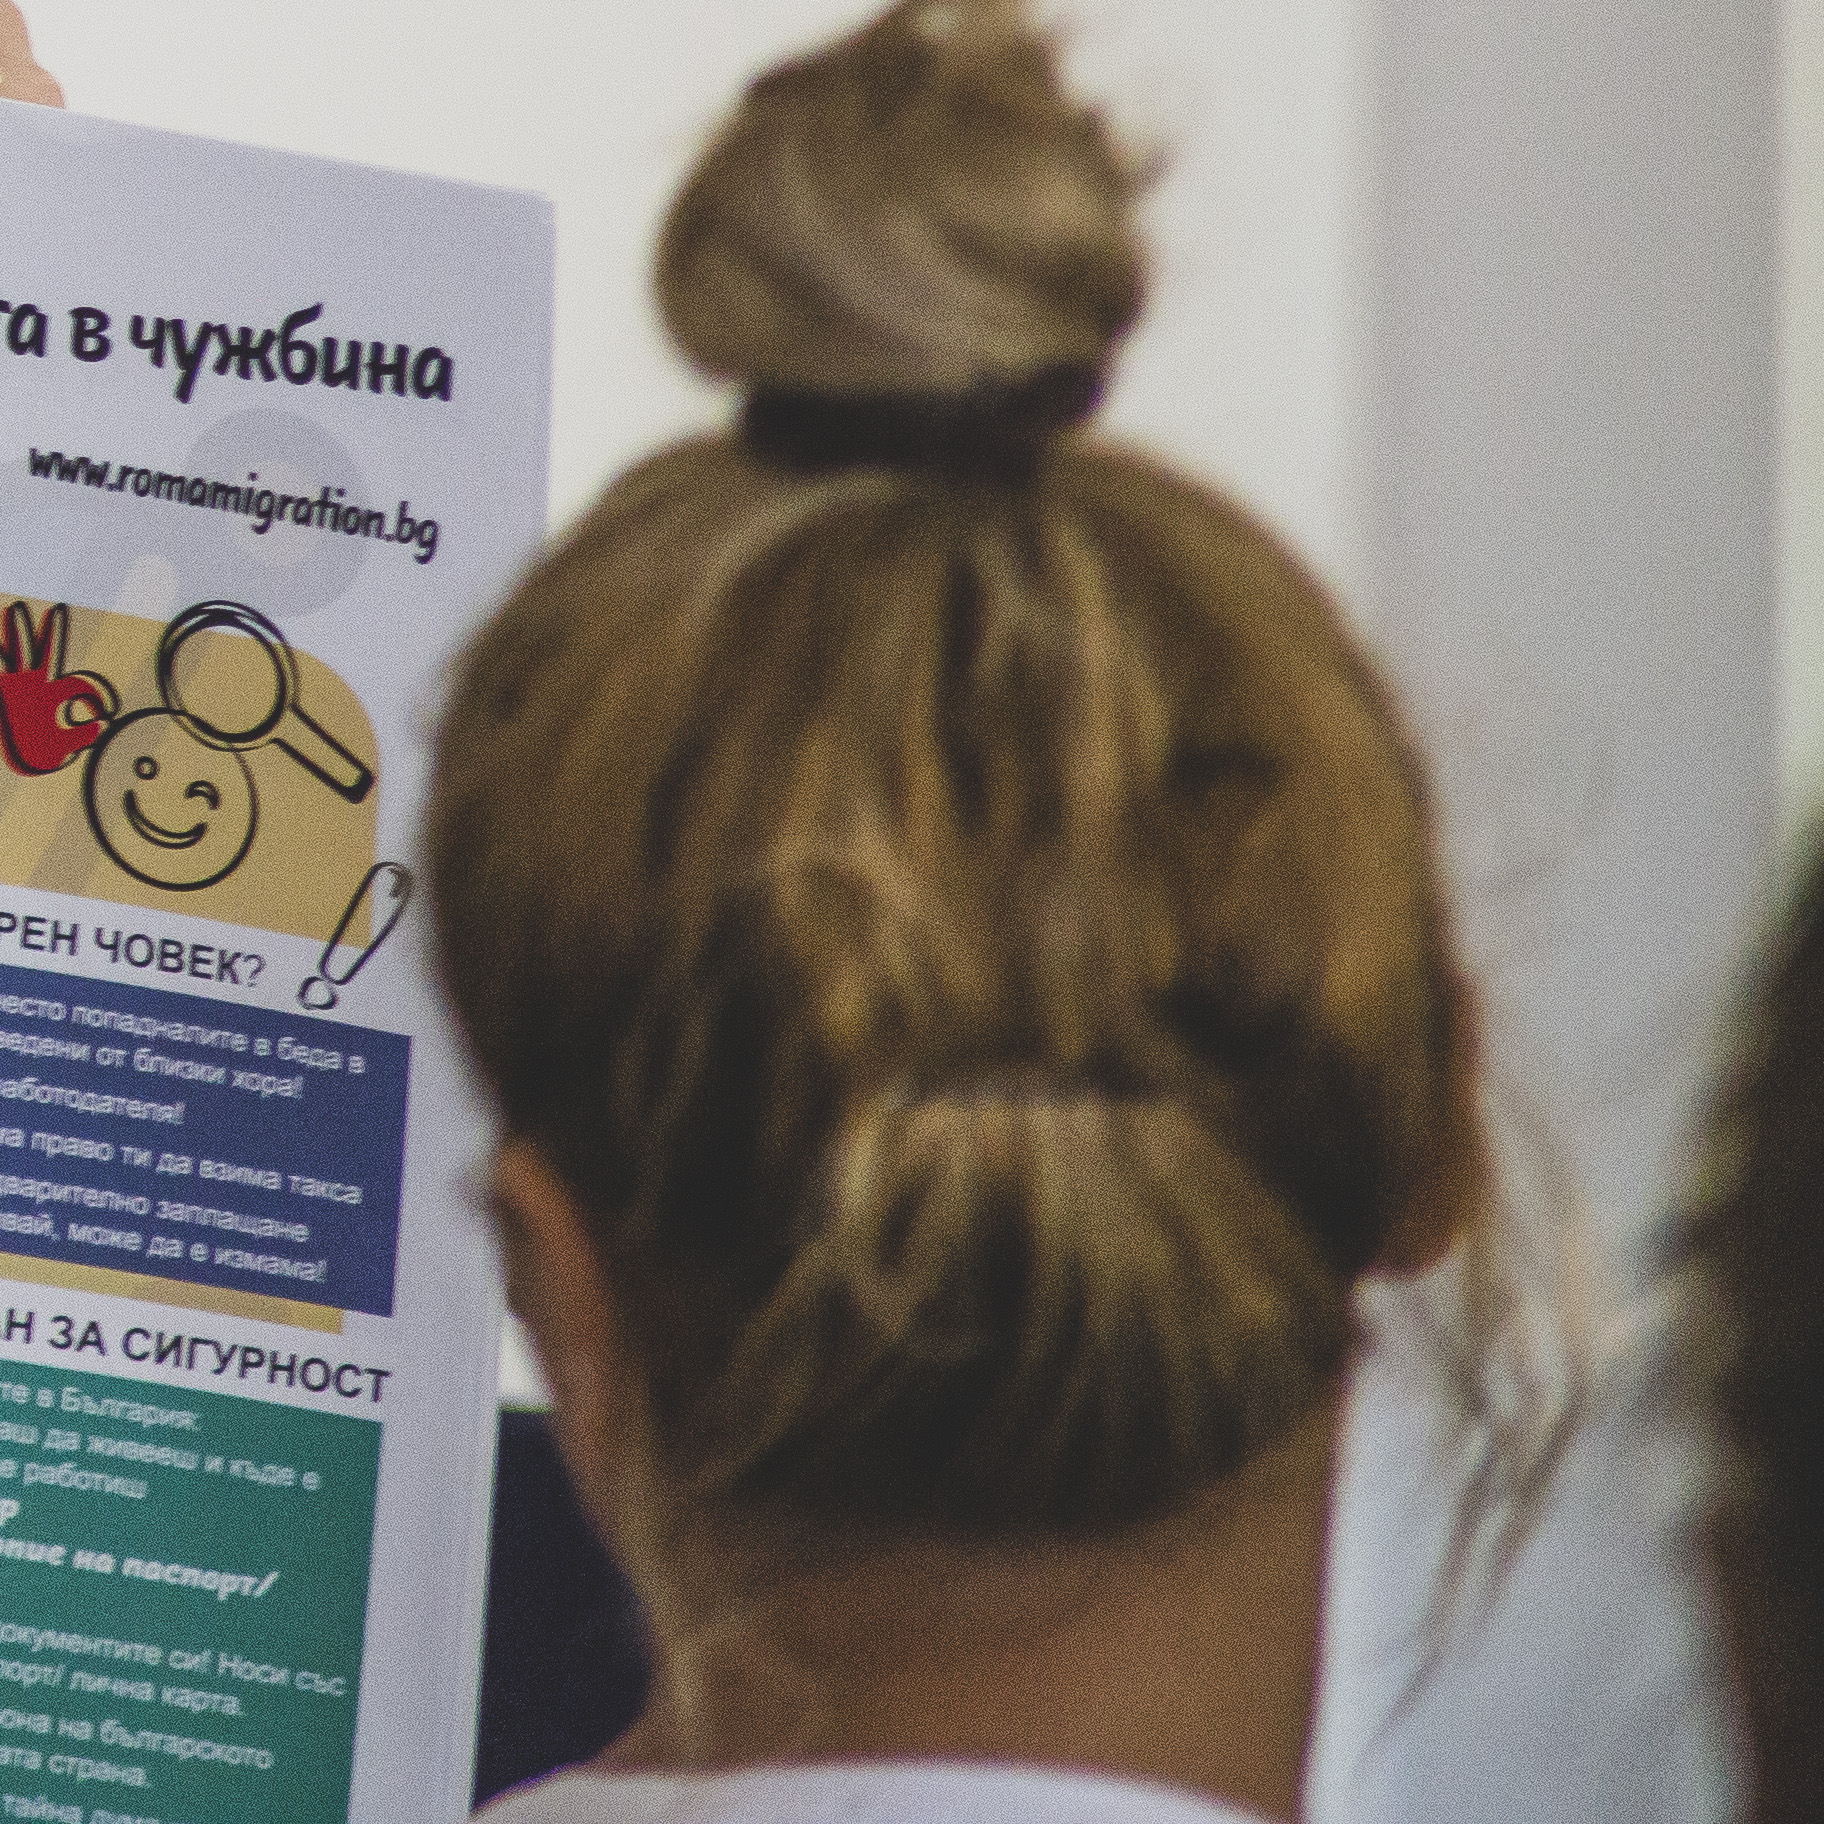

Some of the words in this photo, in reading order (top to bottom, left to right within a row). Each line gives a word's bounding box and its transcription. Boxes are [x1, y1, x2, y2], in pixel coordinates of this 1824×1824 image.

[70, 306, 110, 363] в
[130, 302, 455, 402] чужбина
[28, 446, 439, 564] www.romamigration.bg
[94, 927, 264, 984] ЧОВЕК?
[72, 1005, 248, 1051] попадналите
[277, 1035, 342, 1069] беда
[96, 1046, 127, 1065] от
[133, 1047, 225, 1083] близки
[232, 1070, 302, 1096] хора!
[31, 1131, 113, 1161] право
[121, 1145, 151, 1166] ти
[156, 1152, 192, 1174] да
[198, 1159, 281, 1190] взима
[289, 1174, 361, 1204] такса
[67, 1222, 142, 1251] може
[146, 1235, 183, 1257] да
[214, 1248, 326, 1281] измама!
[156, 1200, 309, 1242] заплащане
[48, 1314, 106, 1355] ЗА
[121, 1326, 391, 1402] СИГУРНОСТ
